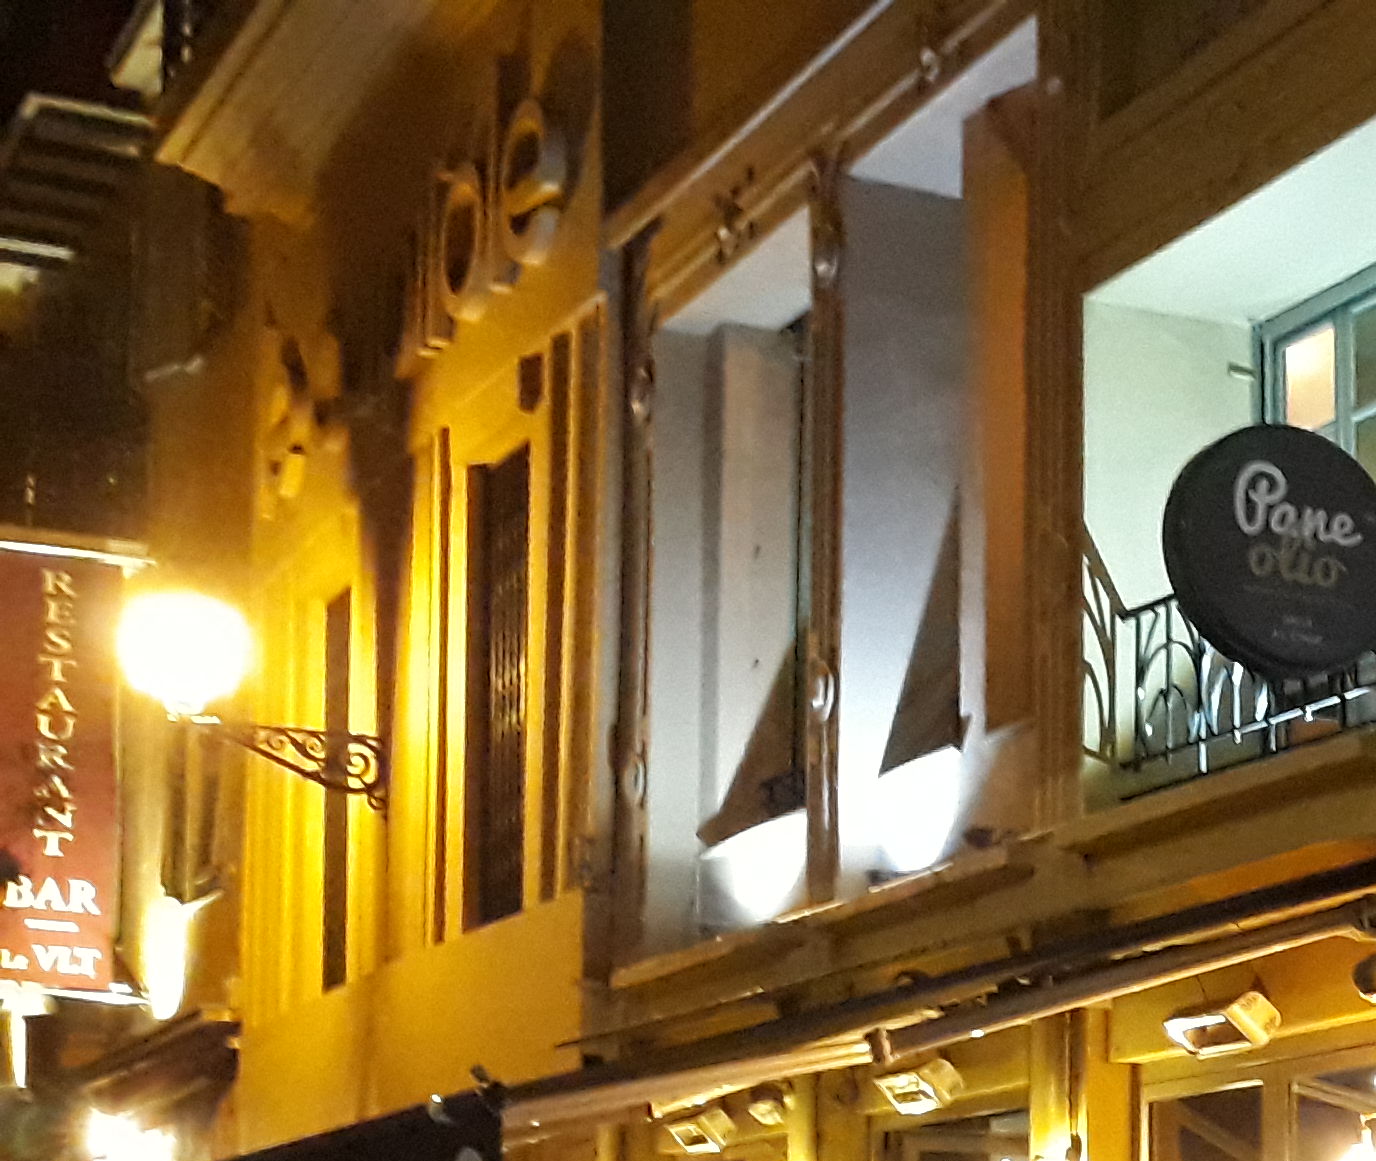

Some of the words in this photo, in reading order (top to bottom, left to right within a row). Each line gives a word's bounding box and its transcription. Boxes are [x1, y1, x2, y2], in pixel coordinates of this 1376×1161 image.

[1234, 460, 1363, 548] Pane
[33, 567, 79, 858] RESTAURANT
[3, 875, 102, 916] BAR
